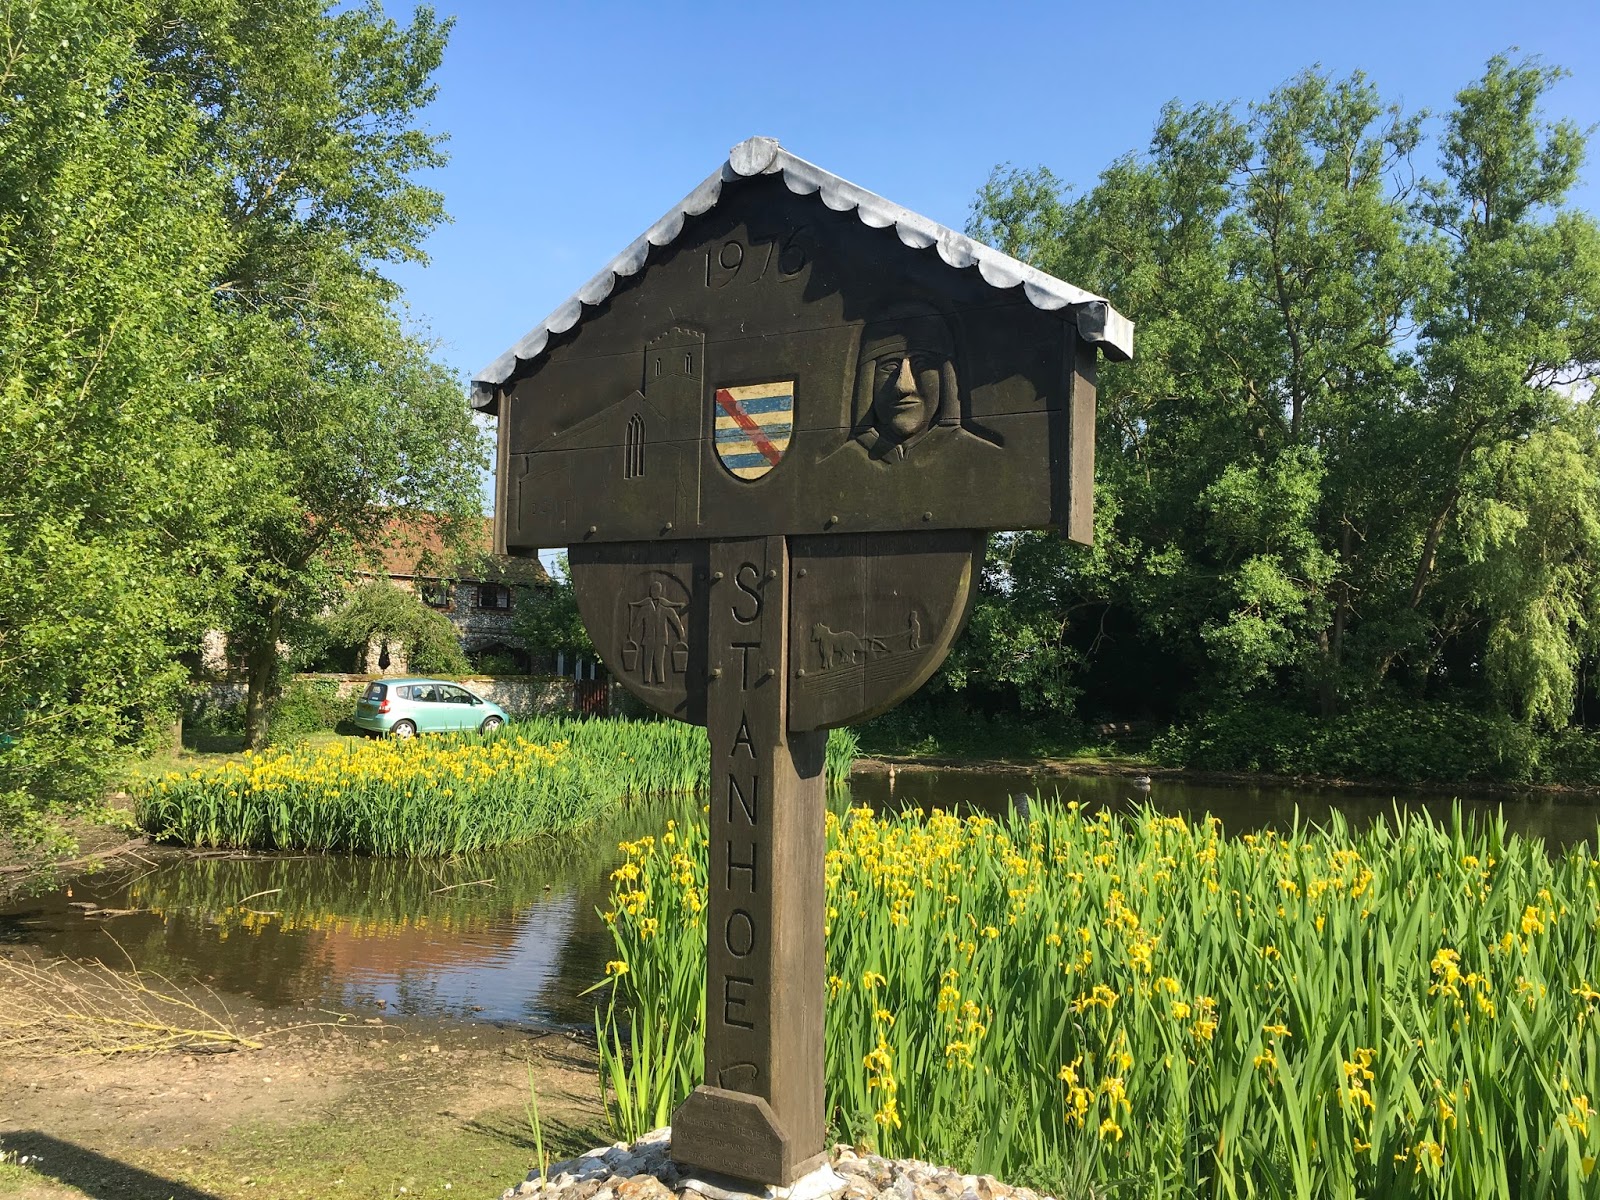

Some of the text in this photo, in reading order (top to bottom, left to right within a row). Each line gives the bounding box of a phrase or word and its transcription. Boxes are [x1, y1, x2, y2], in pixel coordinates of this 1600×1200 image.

[704, 224, 810, 289] 1976
[724, 561, 762, 1030] STANHOE
[732, 1124, 746, 1136] THE
